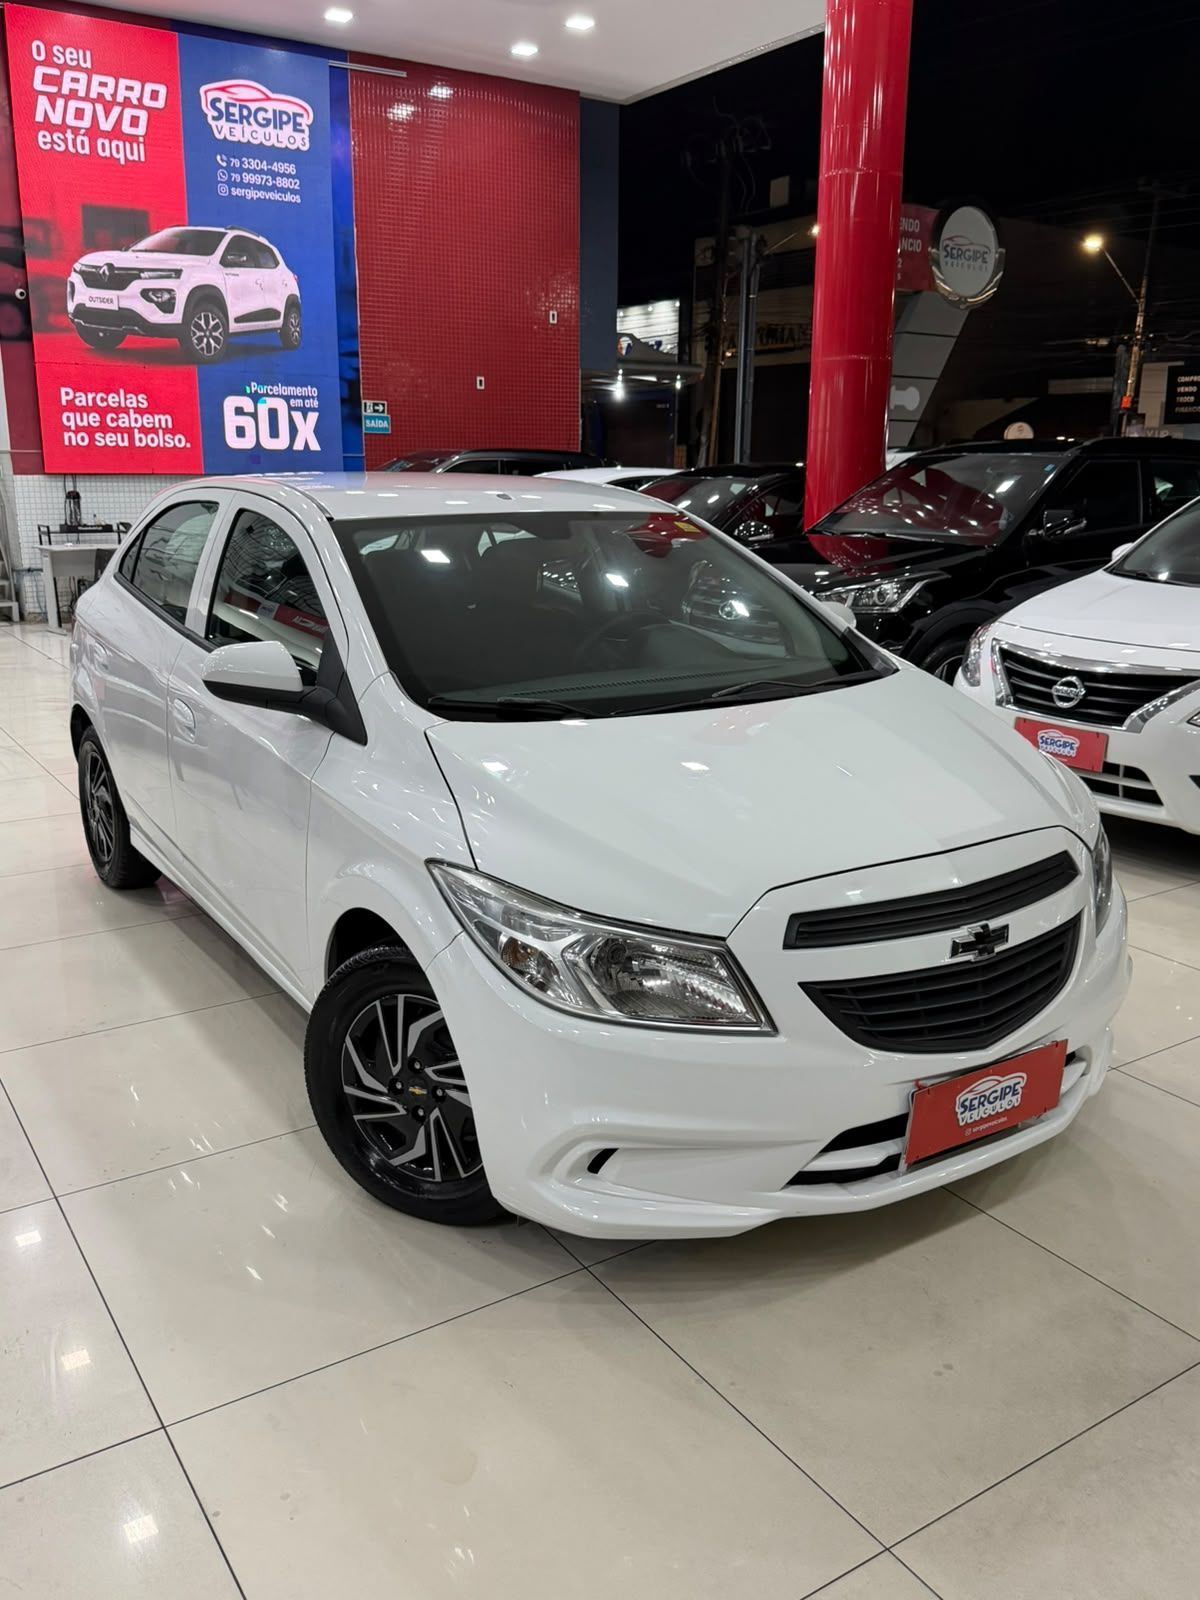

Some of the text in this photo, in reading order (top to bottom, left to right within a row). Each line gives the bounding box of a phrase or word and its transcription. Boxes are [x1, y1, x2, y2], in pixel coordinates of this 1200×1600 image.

[52, 45, 92, 69] seu
[33, 65, 167, 109] CARRO
[35, 95, 148, 136] NOVO
[210, 97, 306, 134] SERGIPE
[38, 129, 145, 165] está aqui
[241, 157, 297, 175] 3304-4956
[242, 172, 301, 190] 99973-8802
[231, 187, 302, 204] sergipeveiculos
[943, 244, 990, 264] SERGIPE
[60, 387, 149, 409] Parcelas
[250, 382, 318, 397] Parcelamento
[290, 398, 319, 409] em até
[62, 408, 173, 431] que cabem
[223, 395, 322, 451] 60x
[365, 418, 389, 428] SAÍDA
[64, 428, 191, 448] no seu bolso.
[1039, 735, 1075, 751] SERGIPE
[960, 1081, 1021, 1115] SERGIPE
